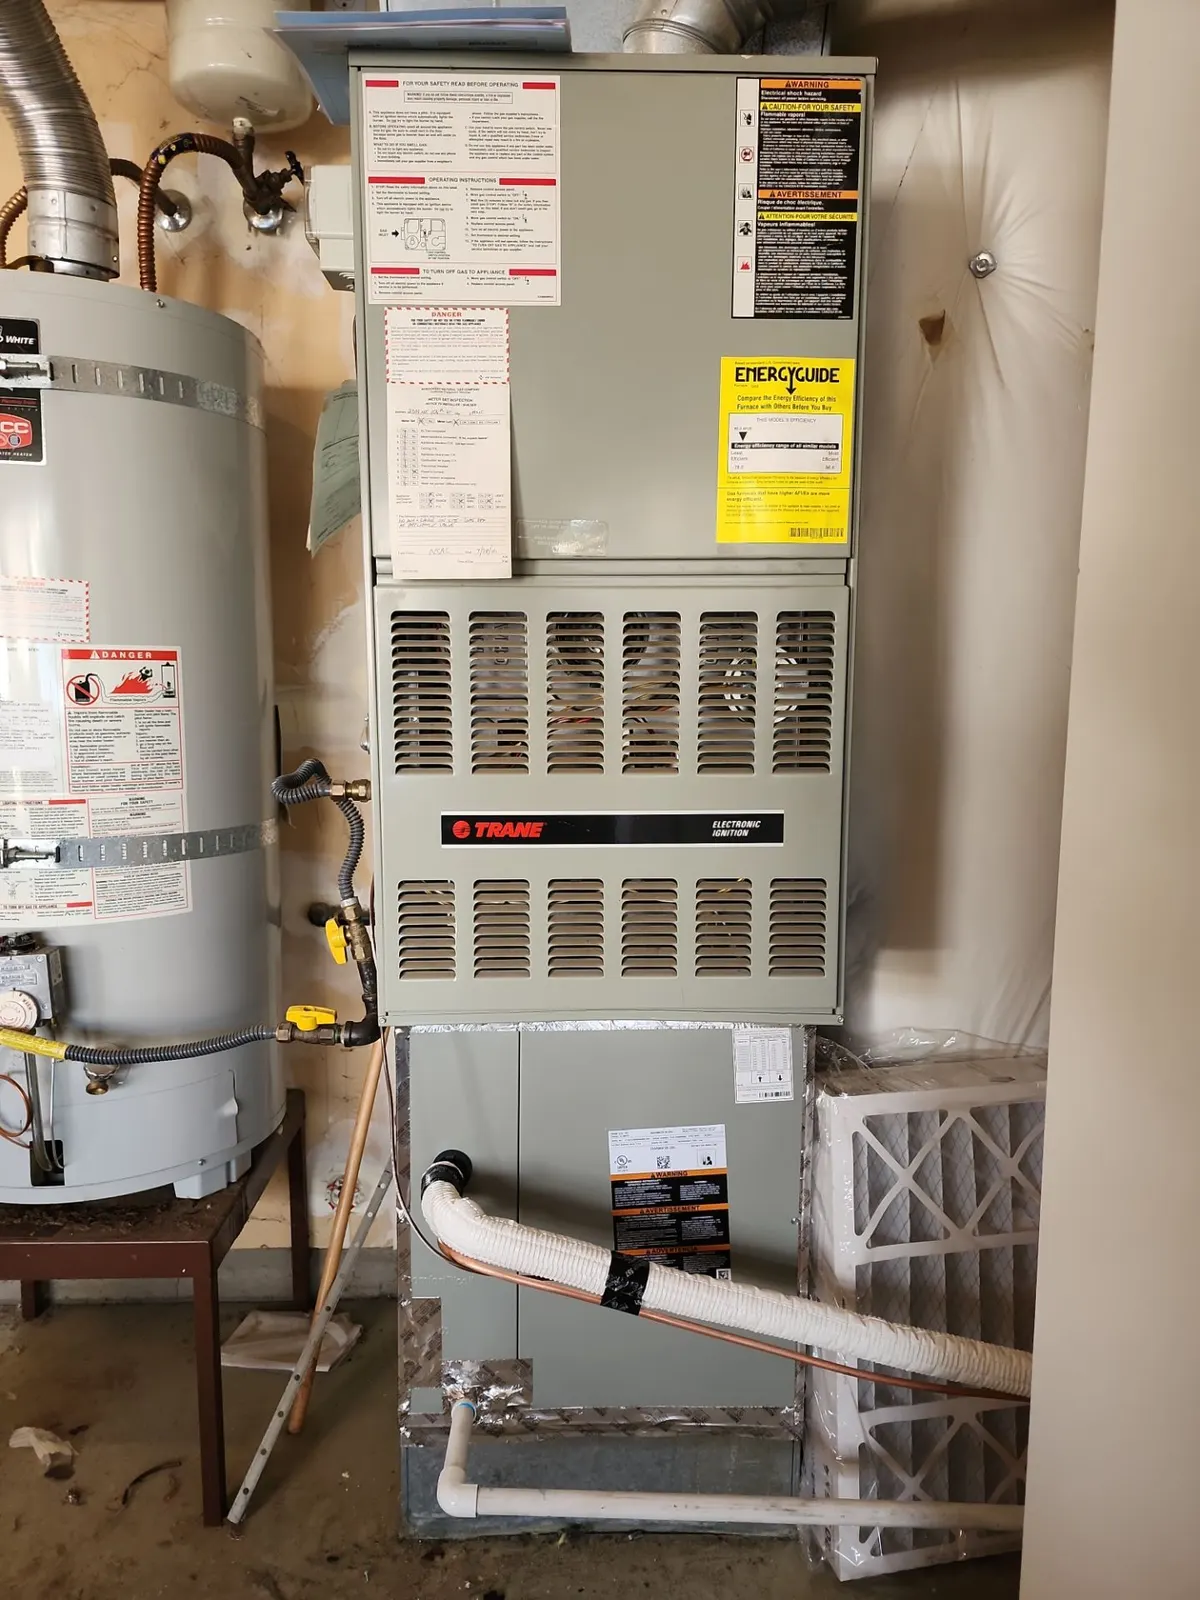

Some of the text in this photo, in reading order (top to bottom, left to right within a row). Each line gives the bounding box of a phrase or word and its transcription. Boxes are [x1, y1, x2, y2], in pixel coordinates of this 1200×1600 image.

[6, 336, 34, 345] WHITE
[735, 367, 839, 383] ENERGYGUIDE
[712, 820, 761, 829] ELECTRONIC
[475, 822, 544, 838] TRANE
[712, 829, 749, 837] IGNITION
